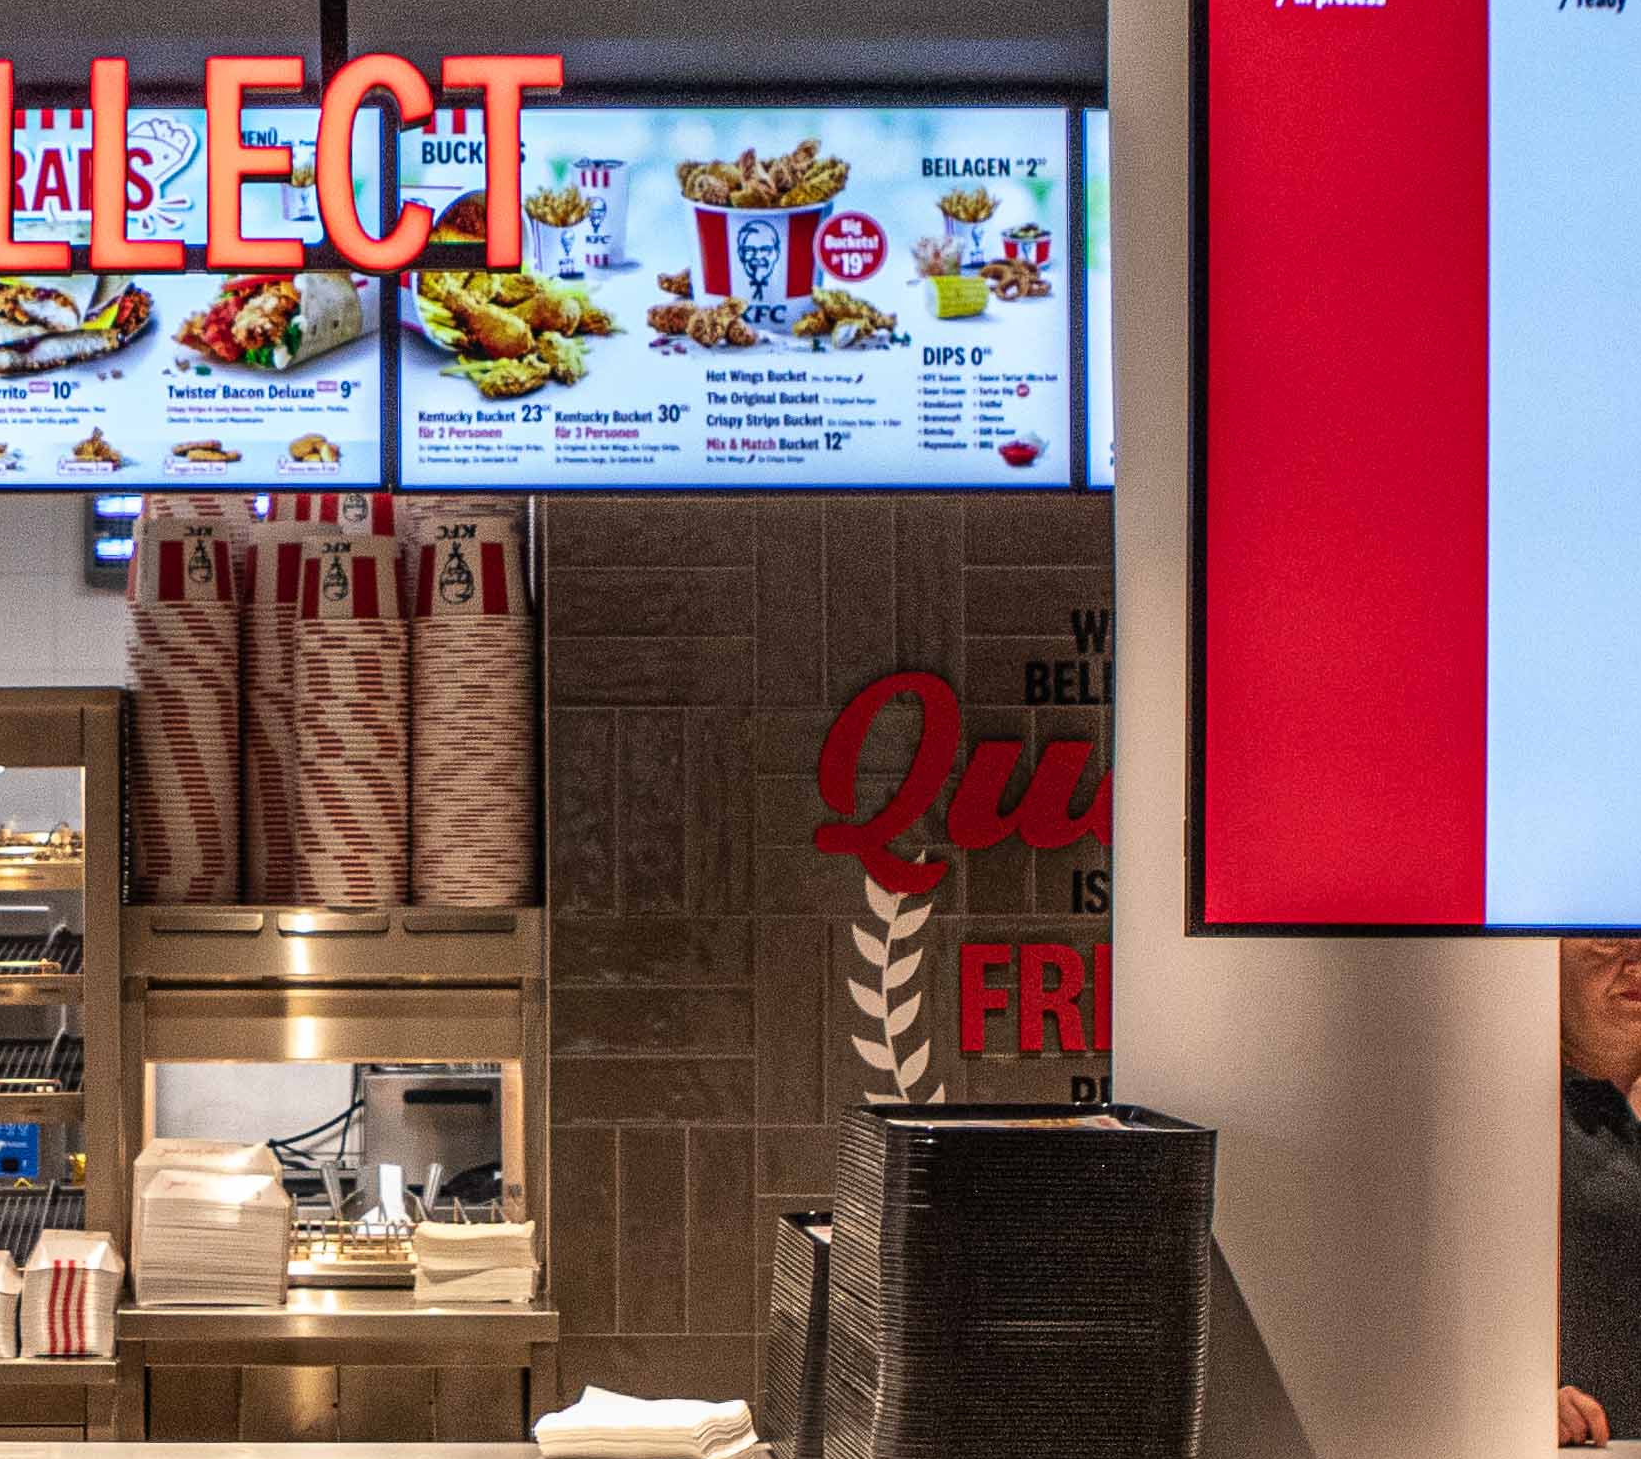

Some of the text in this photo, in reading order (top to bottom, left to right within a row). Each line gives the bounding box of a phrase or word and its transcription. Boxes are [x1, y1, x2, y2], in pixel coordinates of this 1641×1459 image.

[421, 140, 526, 164] BUCKS
[922, 157, 1011, 177] BEILAGEN
[923, 347, 966, 366] DIPS
[706, 369, 727, 383] Hot
[729, 369, 764, 385] Wings
[767, 369, 807, 383] Bucket
[167, 384, 316, 400] Twister Bacon Deluxe
[707, 391, 728, 405] The
[730, 391, 777, 407] Original
[779, 391, 820, 405] Bucket
[418, 410, 516, 425] Kentucky Bucket
[554, 410, 653, 425] Kentucky Bucket
[706, 414, 743, 429] Crispy
[745, 414, 780, 429] Strips
[783, 414, 824, 427] Bucket
[418, 426, 503, 439] für 2 Personen
[555, 426, 572, 439] für
[585, 426, 640, 439] Personen
[706, 437, 820, 451] Mix & Match Bucket
[184, 525, 213, 538] KFC
[436, 524, 476, 540] KFC
[321, 542, 351, 555] KFC
[1070, 608, 1112, 654] W
[1070, 870, 1110, 915] IS
